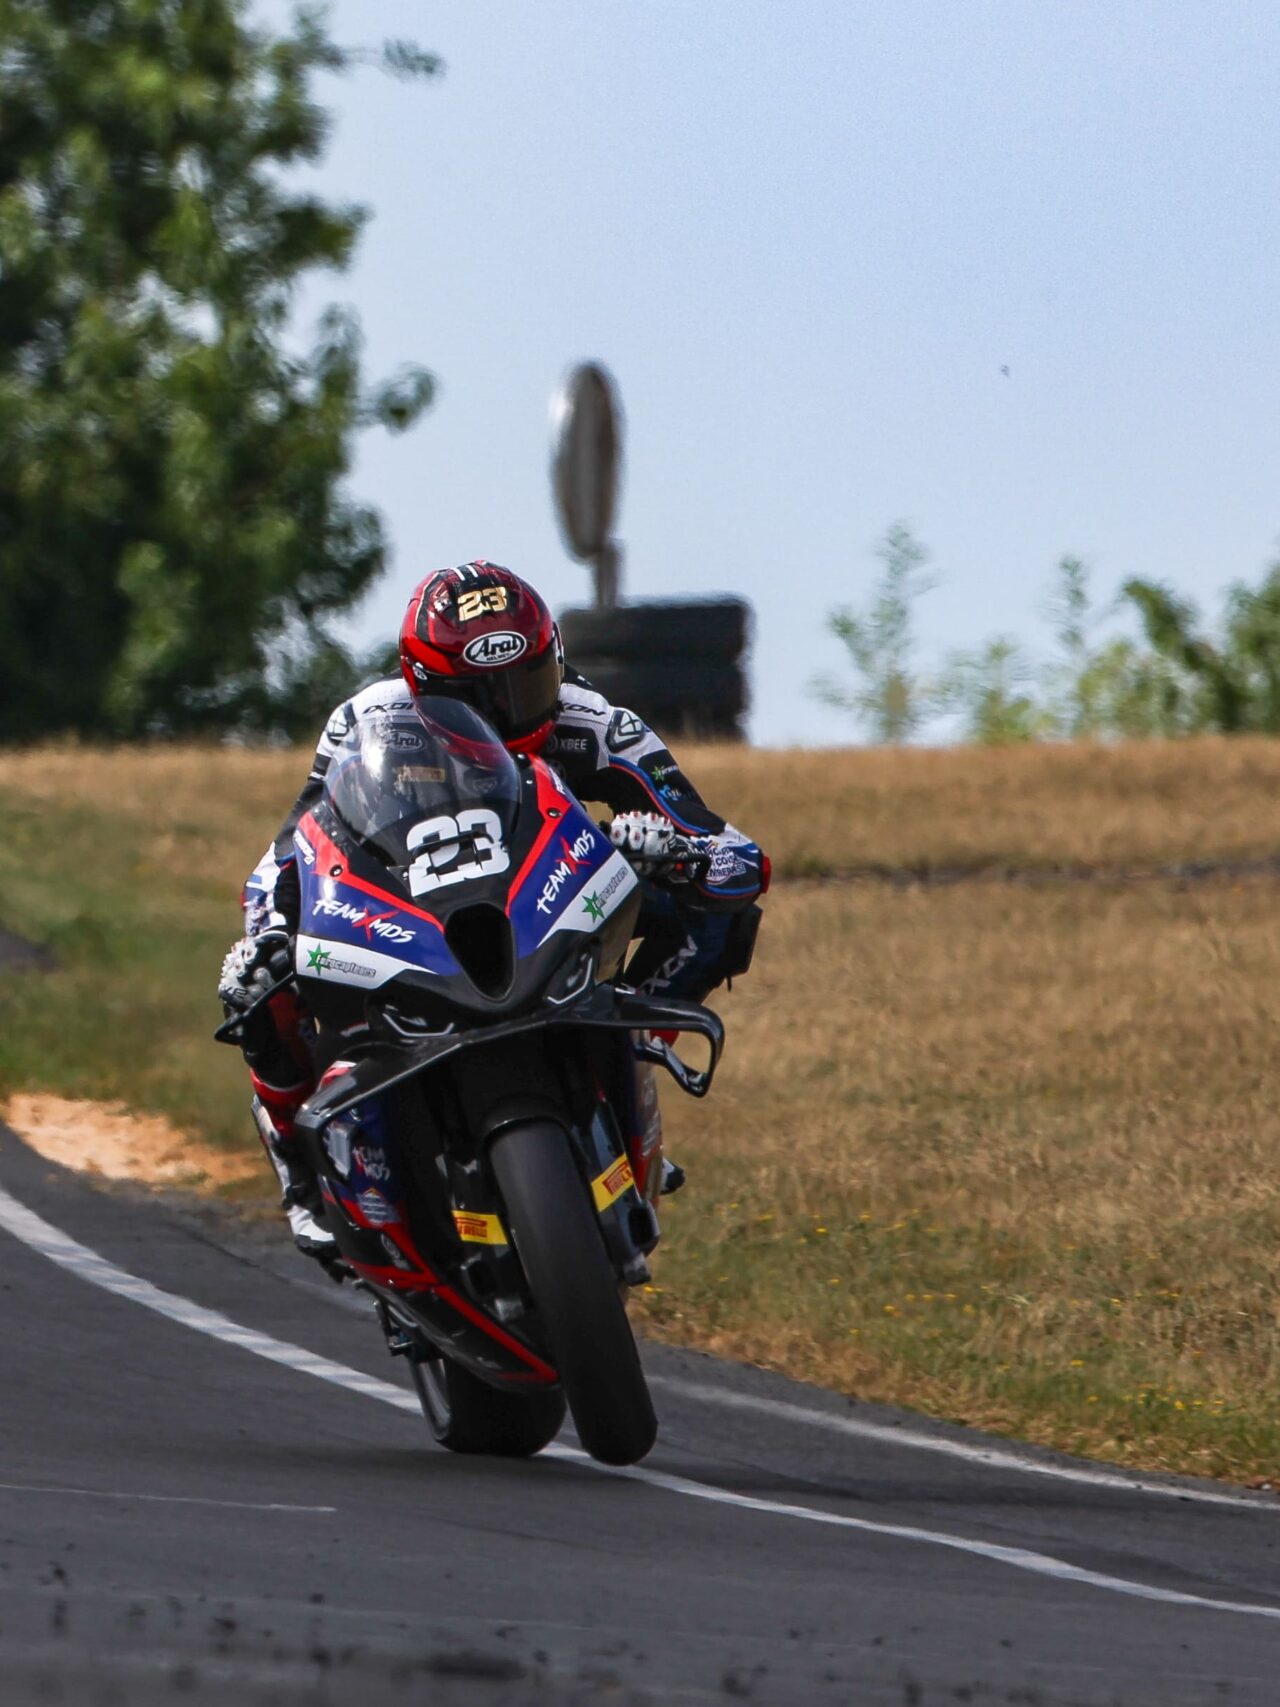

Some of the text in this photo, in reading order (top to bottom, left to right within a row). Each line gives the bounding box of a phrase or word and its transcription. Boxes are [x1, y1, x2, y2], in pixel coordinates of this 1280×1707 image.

[457, 586, 507, 621] 23
[470, 636, 519, 659] Arai
[406, 808, 510, 897] 23
